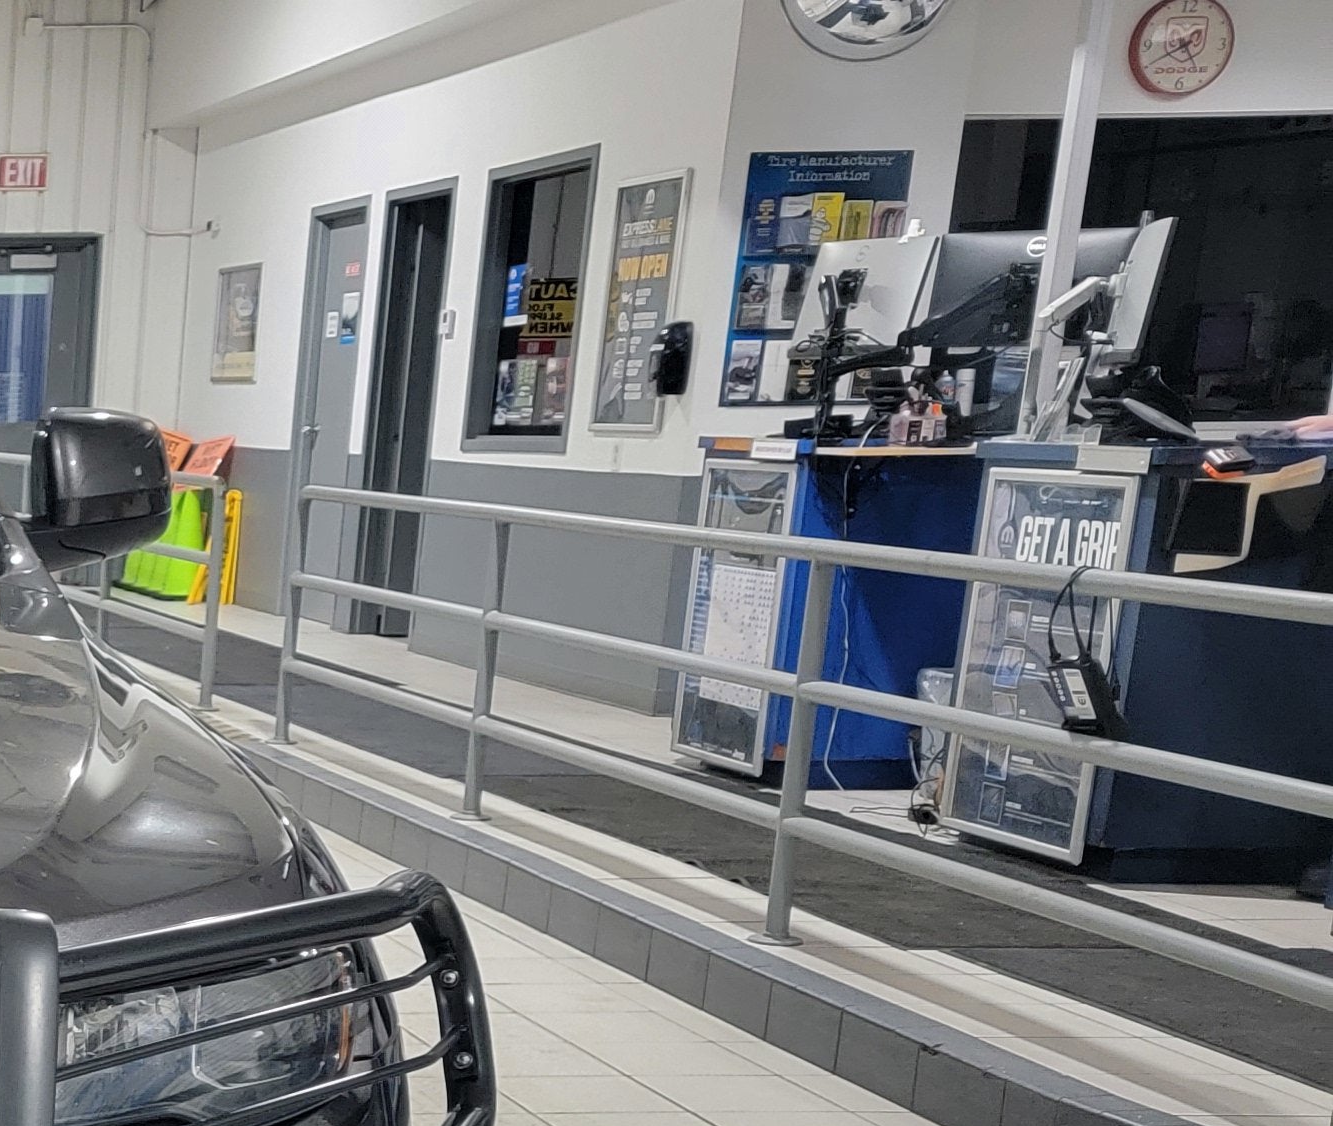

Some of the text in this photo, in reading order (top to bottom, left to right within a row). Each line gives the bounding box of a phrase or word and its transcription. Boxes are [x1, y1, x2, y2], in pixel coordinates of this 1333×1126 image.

[1180, 0, 1198, 13] 12
[1141, 39, 1152, 52] 9
[1216, 37, 1227, 51] 3
[1154, 66, 1208, 74] DODGE
[1174, 77, 1185, 90] 6
[767, 153, 896, 167] Tire Manufacturer
[4, 158, 45, 187] EXIT
[788, 169, 871, 182] Information
[640, 253, 669, 279] OPEN
[1015, 515, 1056, 564] GET
[1053, 518, 1071, 566] A
